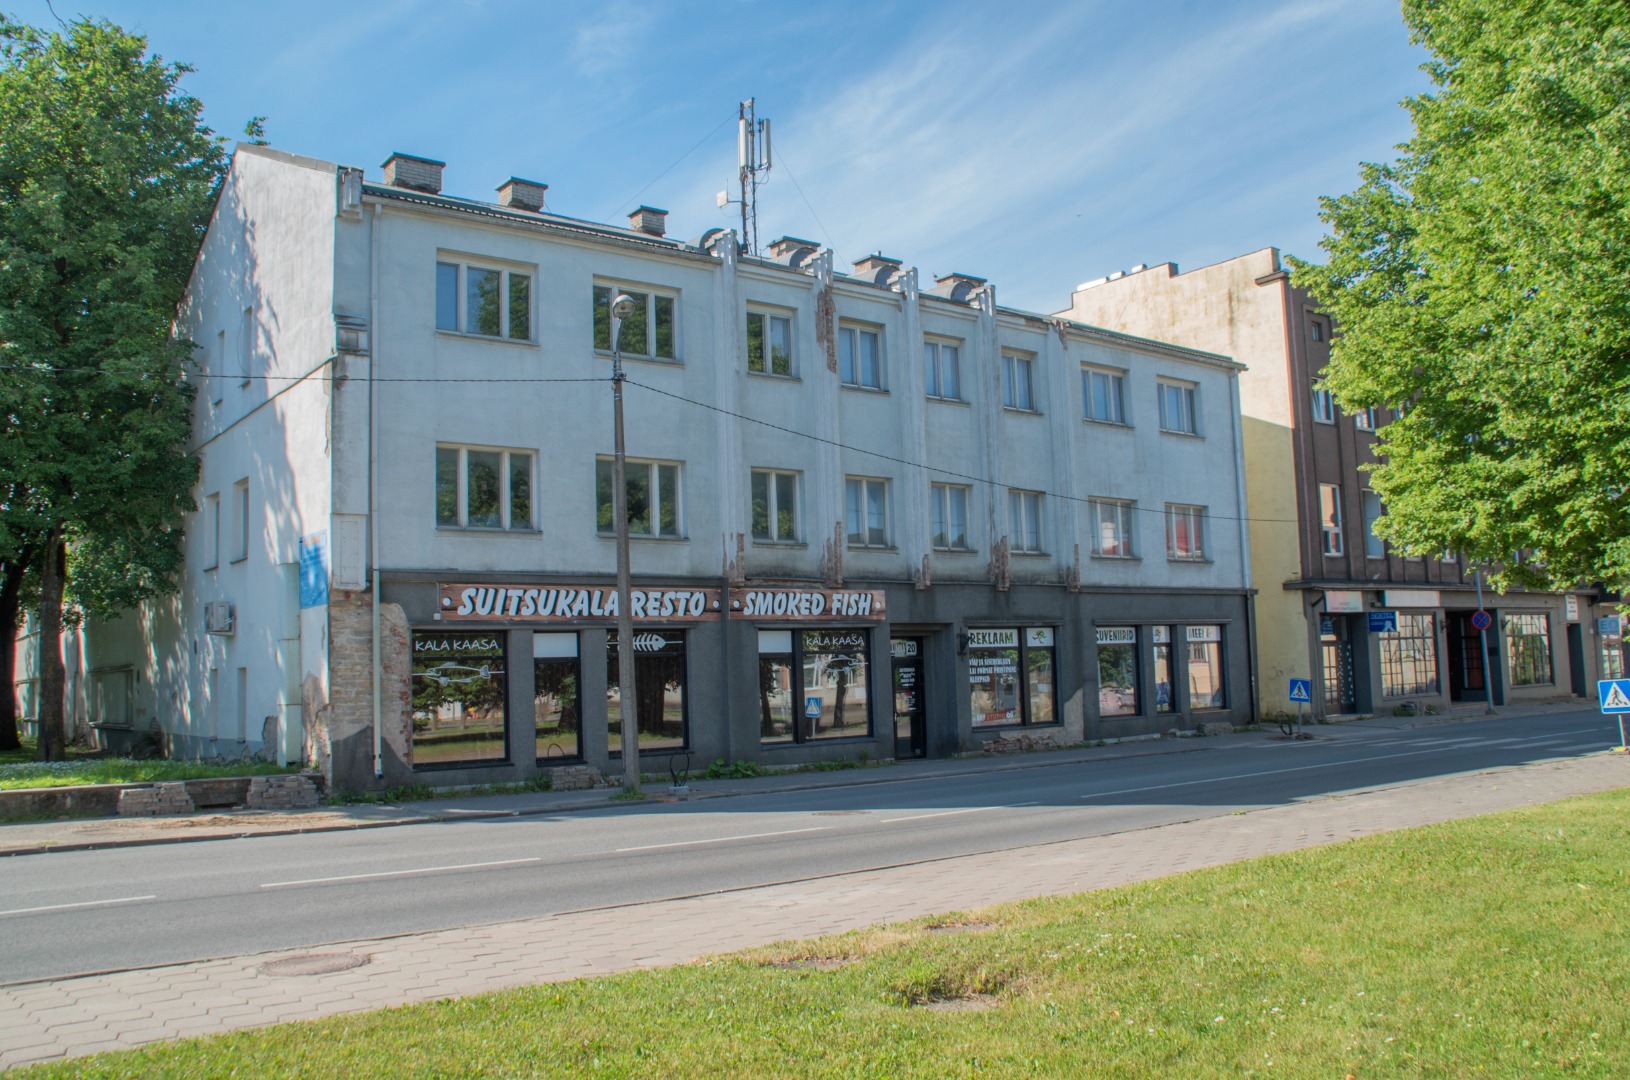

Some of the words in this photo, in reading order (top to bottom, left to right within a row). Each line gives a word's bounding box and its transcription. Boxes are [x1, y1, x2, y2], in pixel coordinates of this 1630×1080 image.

[457, 587, 619, 618] SUITSUKALA
[631, 590, 707, 618] RESTO
[743, 591, 826, 617] SMOKED
[831, 592, 872, 616] FISH
[806, 636, 831, 647] KALA
[832, 635, 866, 647] KAASA
[970, 631, 1014, 645] REKLAAM
[1095, 629, 1134, 641] SUVENIIRID
[415, 639, 450, 652] KALA
[453, 638, 499, 651] KAASA
[907, 643, 916, 653] 20
